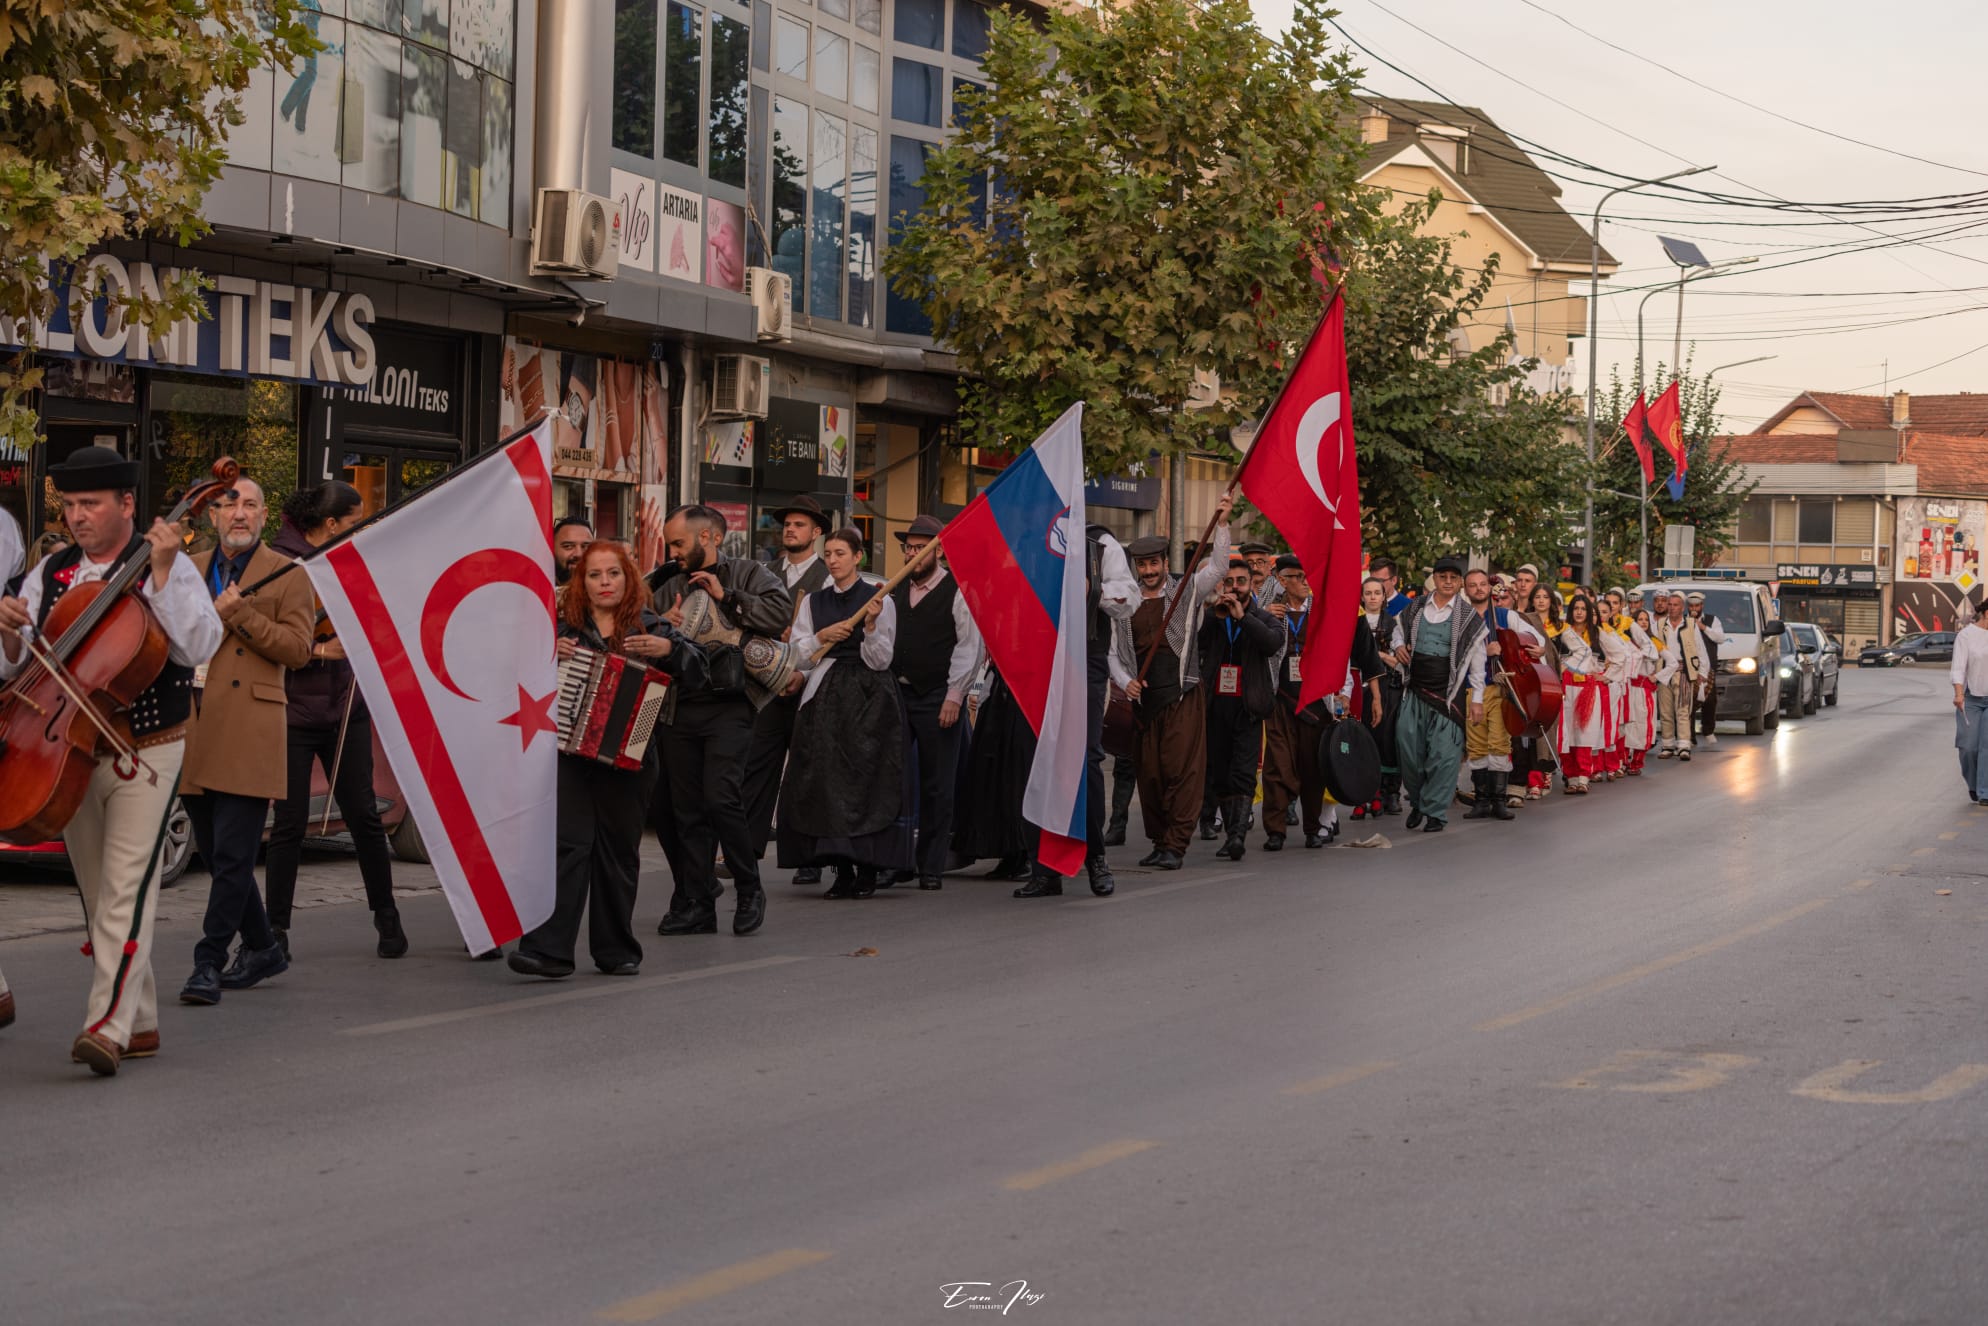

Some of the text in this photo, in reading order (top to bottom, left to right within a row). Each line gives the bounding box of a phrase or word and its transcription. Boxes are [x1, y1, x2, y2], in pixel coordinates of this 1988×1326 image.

[663, 191, 699, 224] ARTARIA
[209, 275, 377, 385] TEKS
[651, 342, 663, 360] 20
[419, 387, 449, 413] TEKS
[787, 439, 817, 460] TE BANI
